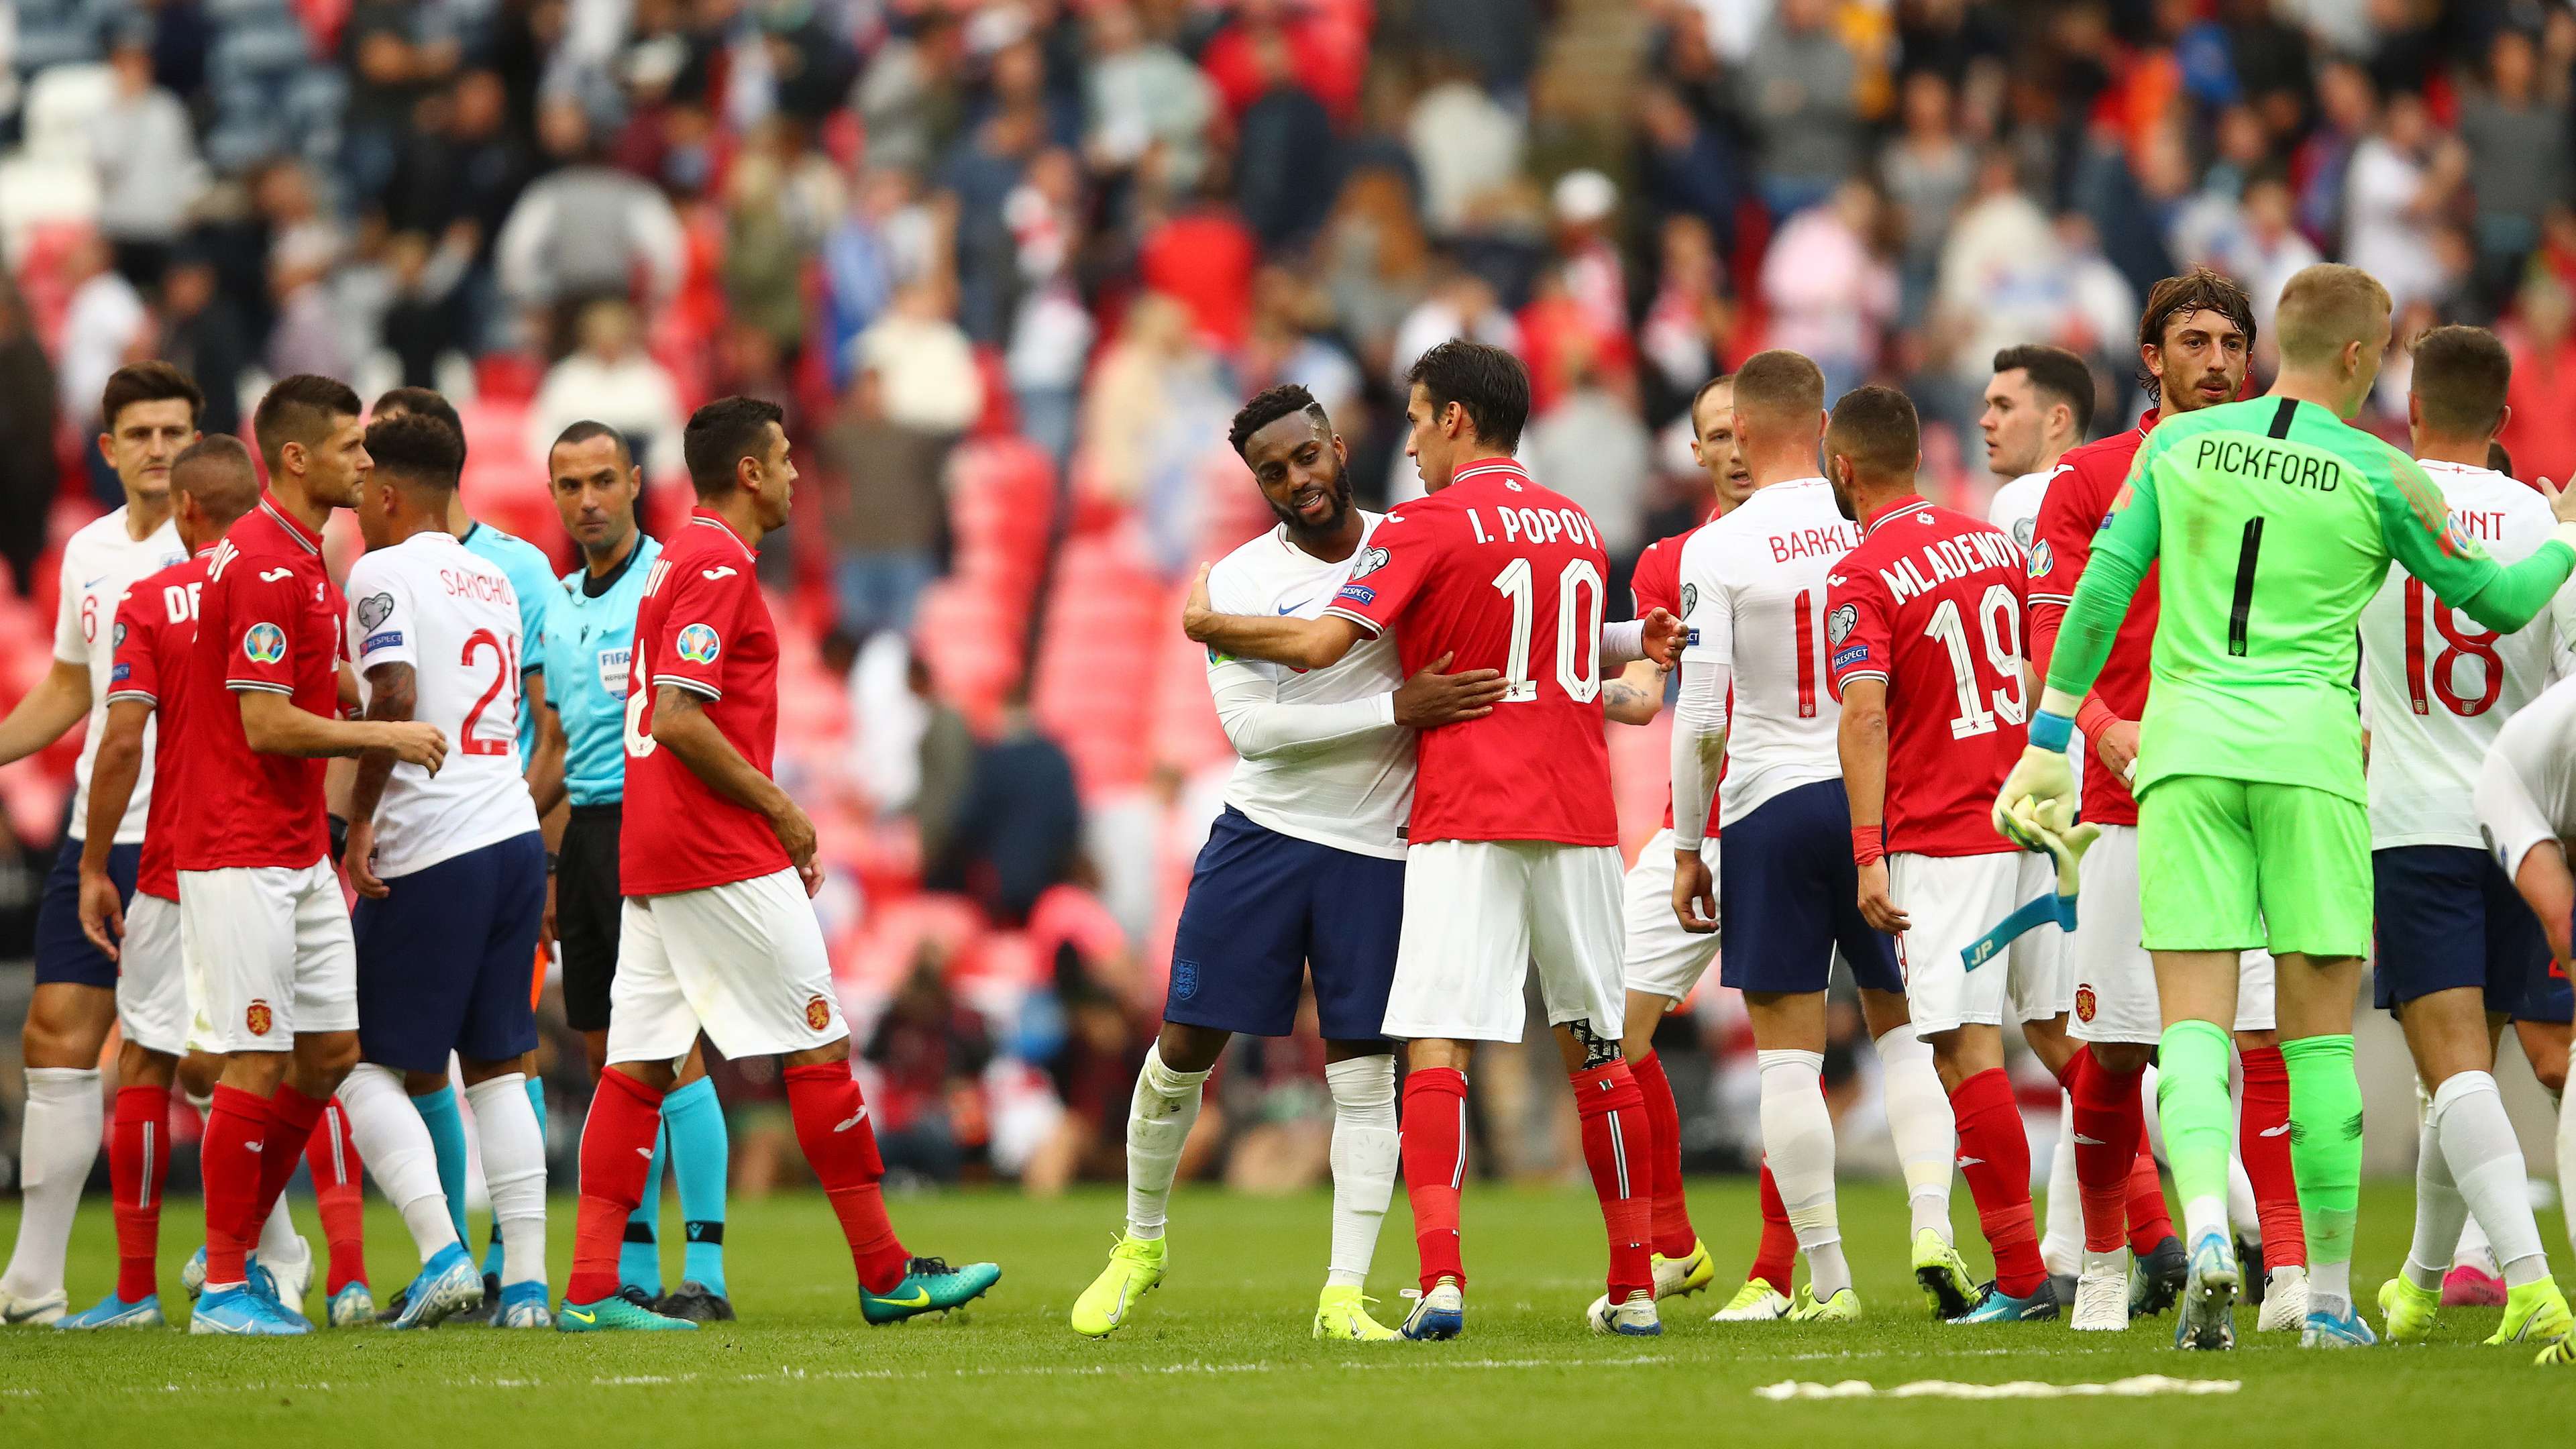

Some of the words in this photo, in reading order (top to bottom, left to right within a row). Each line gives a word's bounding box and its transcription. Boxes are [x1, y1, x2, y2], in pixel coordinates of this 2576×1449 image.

[2197, 440, 2340, 491] PICKFORD
[1466, 508, 1495, 544] I.
[1497, 506, 1597, 550] POPOV
[440, 569, 512, 605] SANCHO
[1879, 532, 2020, 606] MLADENOV
[2229, 515, 2265, 657] 1
[81, 594, 97, 644] 6
[368, 634, 402, 649] RESPECT
[1491, 557, 1604, 704] 10
[602, 652, 631, 665] FIFA
[1836, 649, 1868, 666] RESPECT
[1923, 584, 2028, 740] 19
[2405, 574, 2504, 717] 18
[461, 628, 521, 755] 21
[1971, 938, 1994, 965] JP
